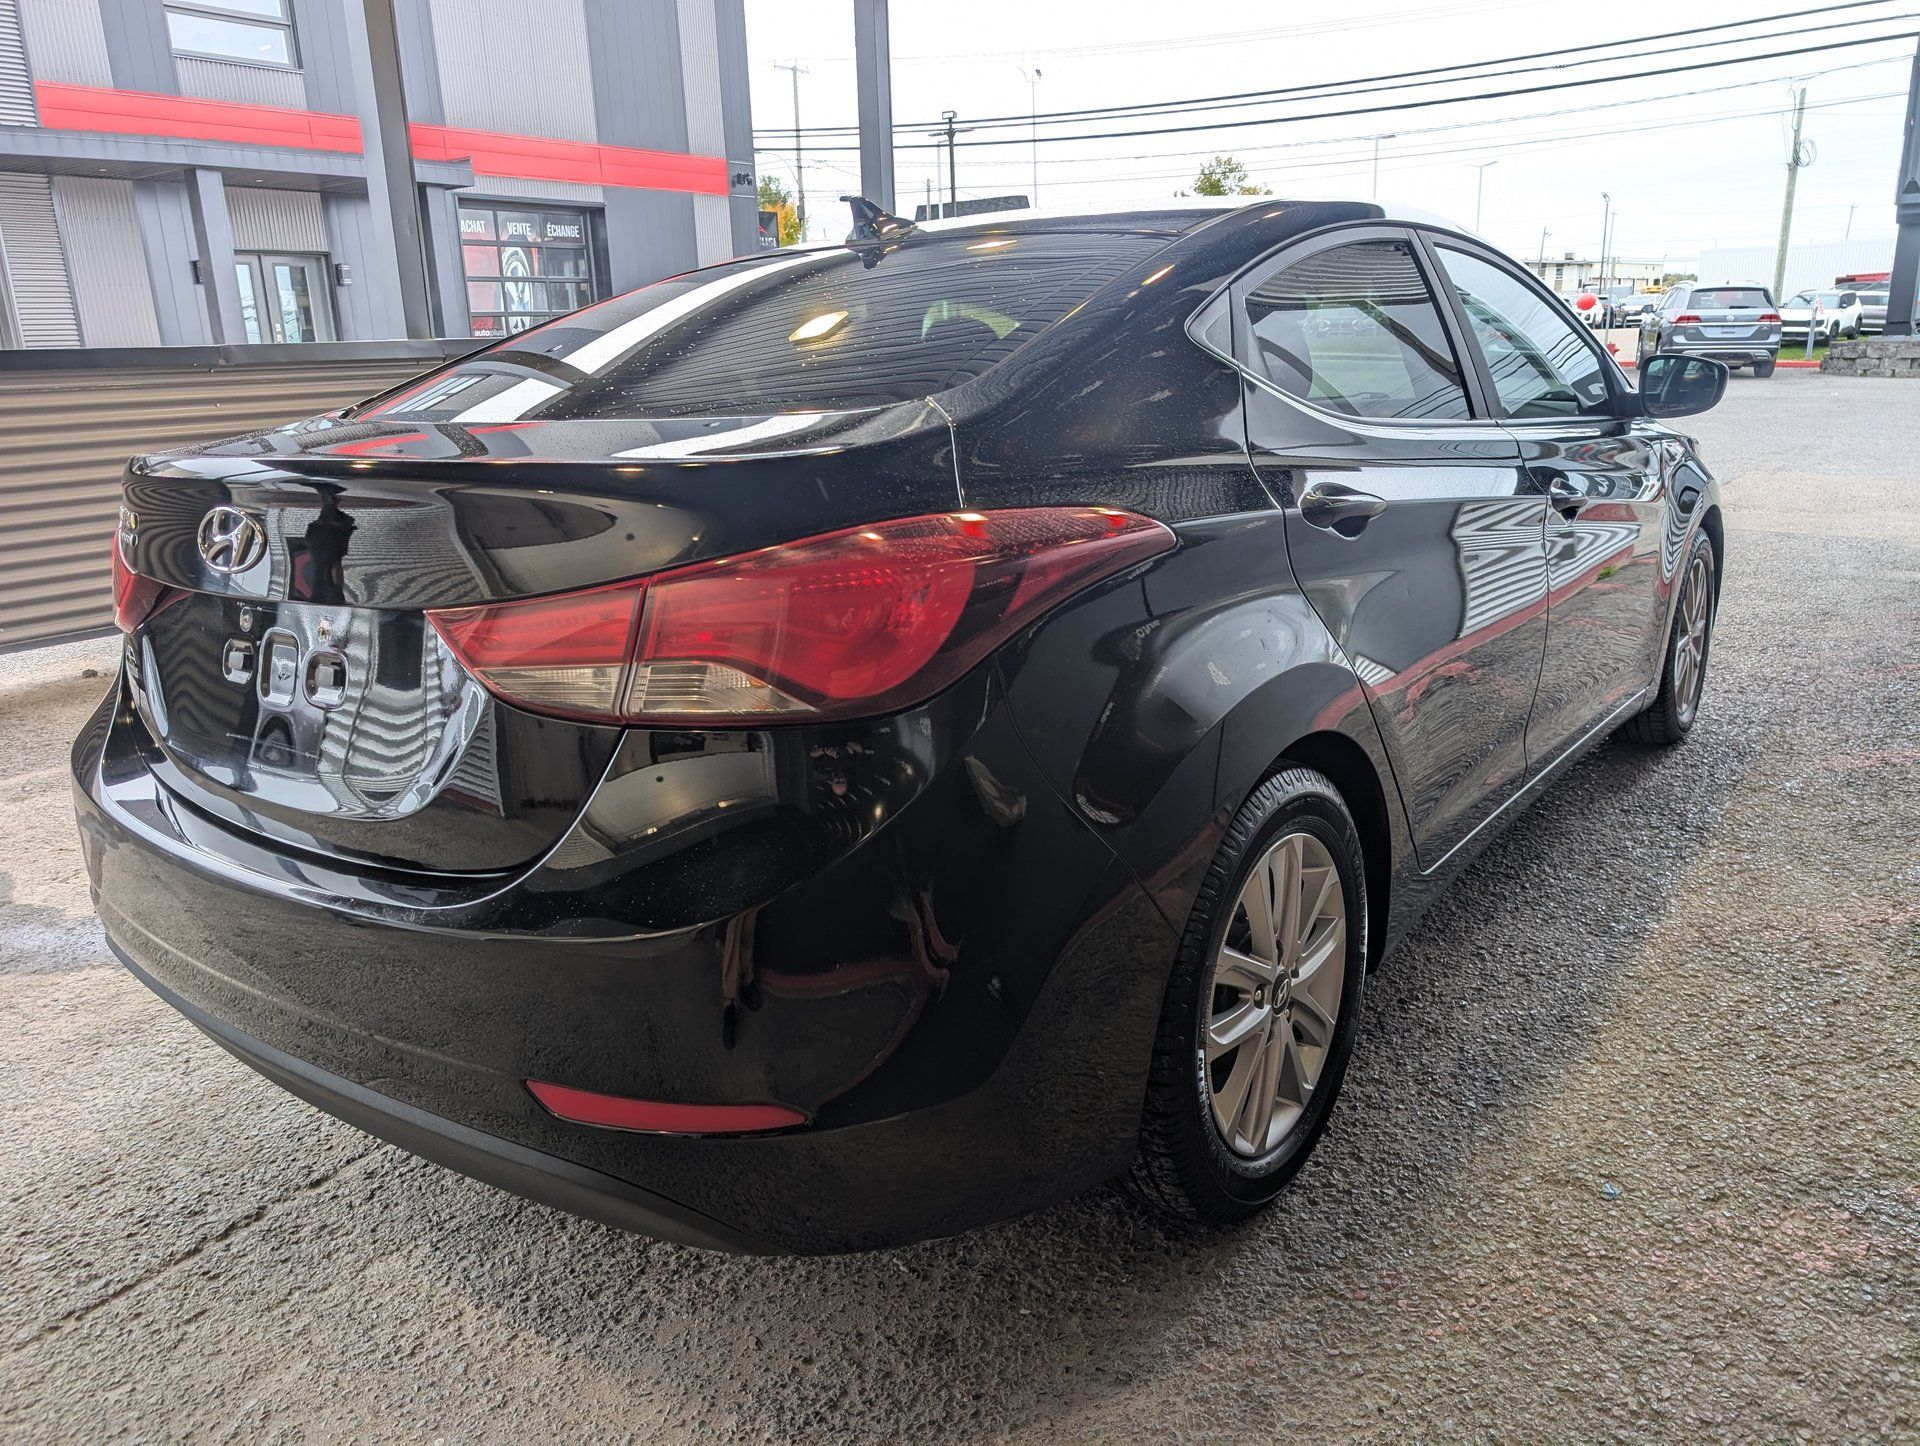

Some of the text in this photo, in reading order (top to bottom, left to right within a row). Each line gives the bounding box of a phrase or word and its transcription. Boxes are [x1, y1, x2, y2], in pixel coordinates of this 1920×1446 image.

[460, 220, 580, 238] ACHAT VENTE ÉCHANGE
